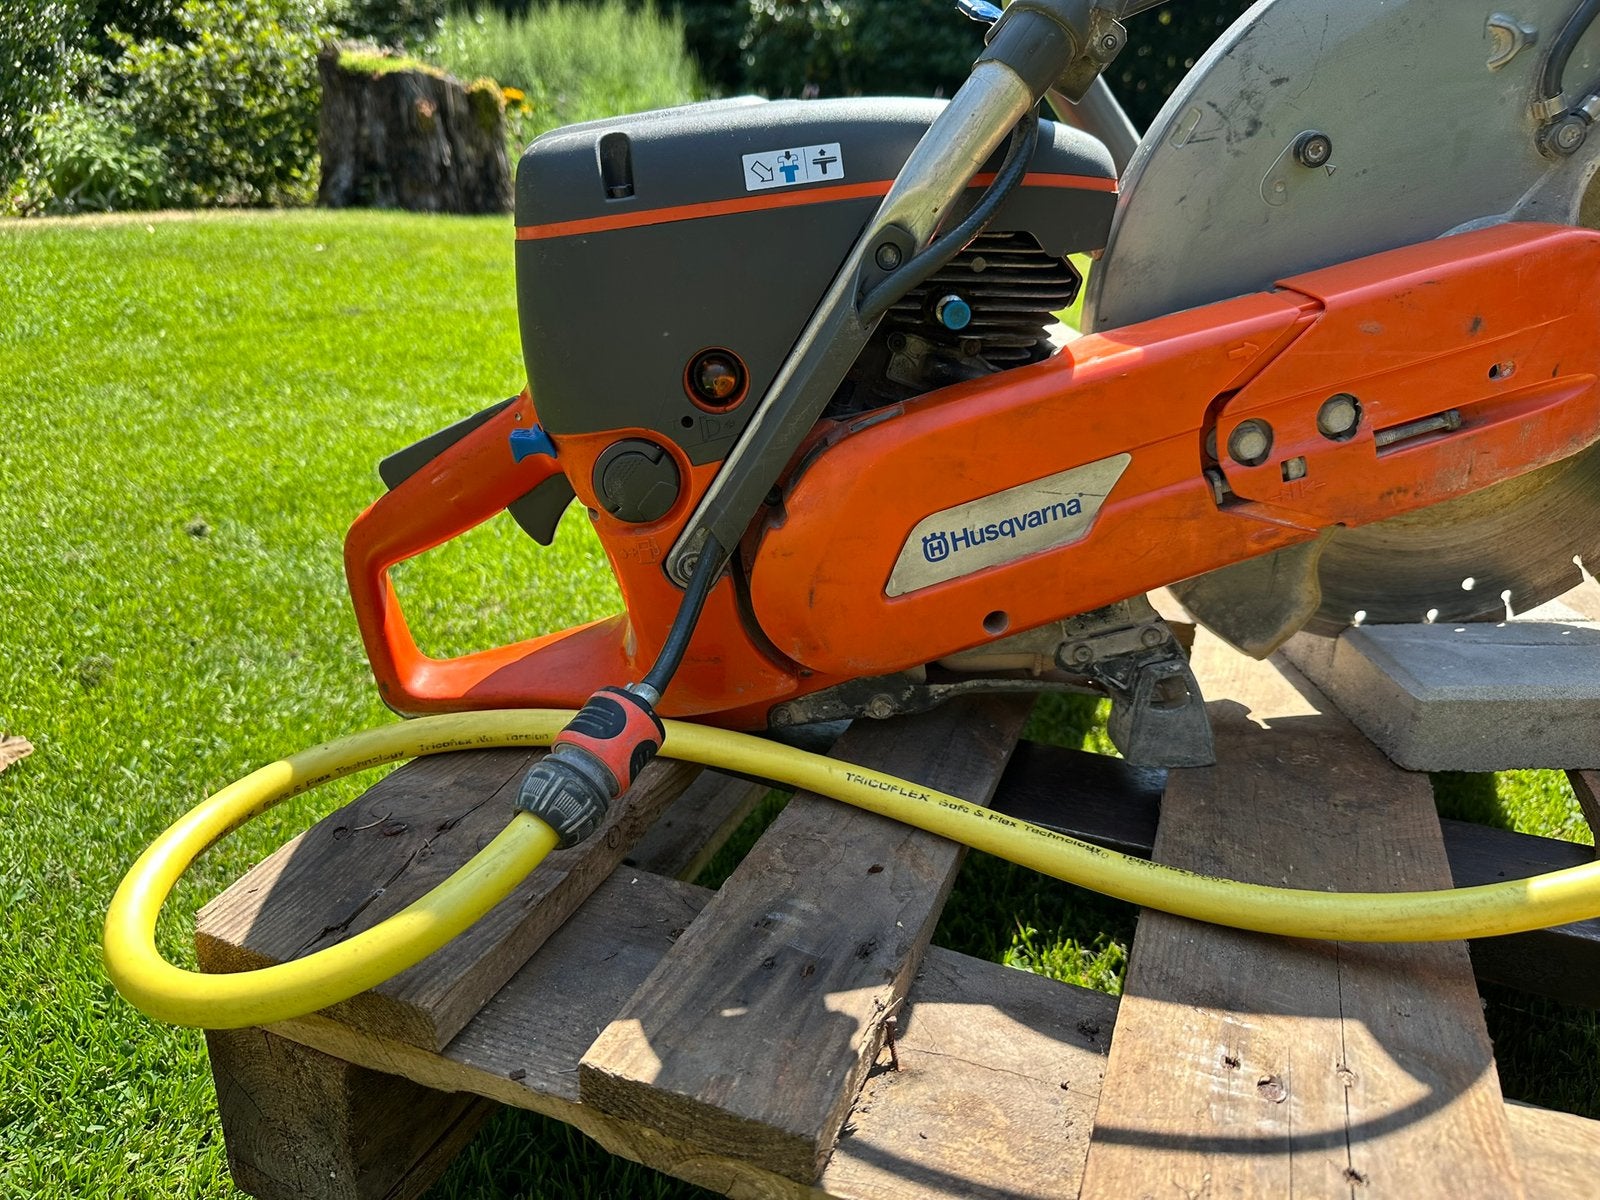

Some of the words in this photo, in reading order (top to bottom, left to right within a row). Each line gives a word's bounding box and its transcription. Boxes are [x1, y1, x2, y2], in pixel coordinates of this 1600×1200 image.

[950, 498, 1082, 552] Husqvarna
[846, 772, 931, 803] TRICOFLEX
[974, 808, 984, 818] &
[988, 813, 1018, 829] Flex
[1024, 824, 1103, 856] Technology
